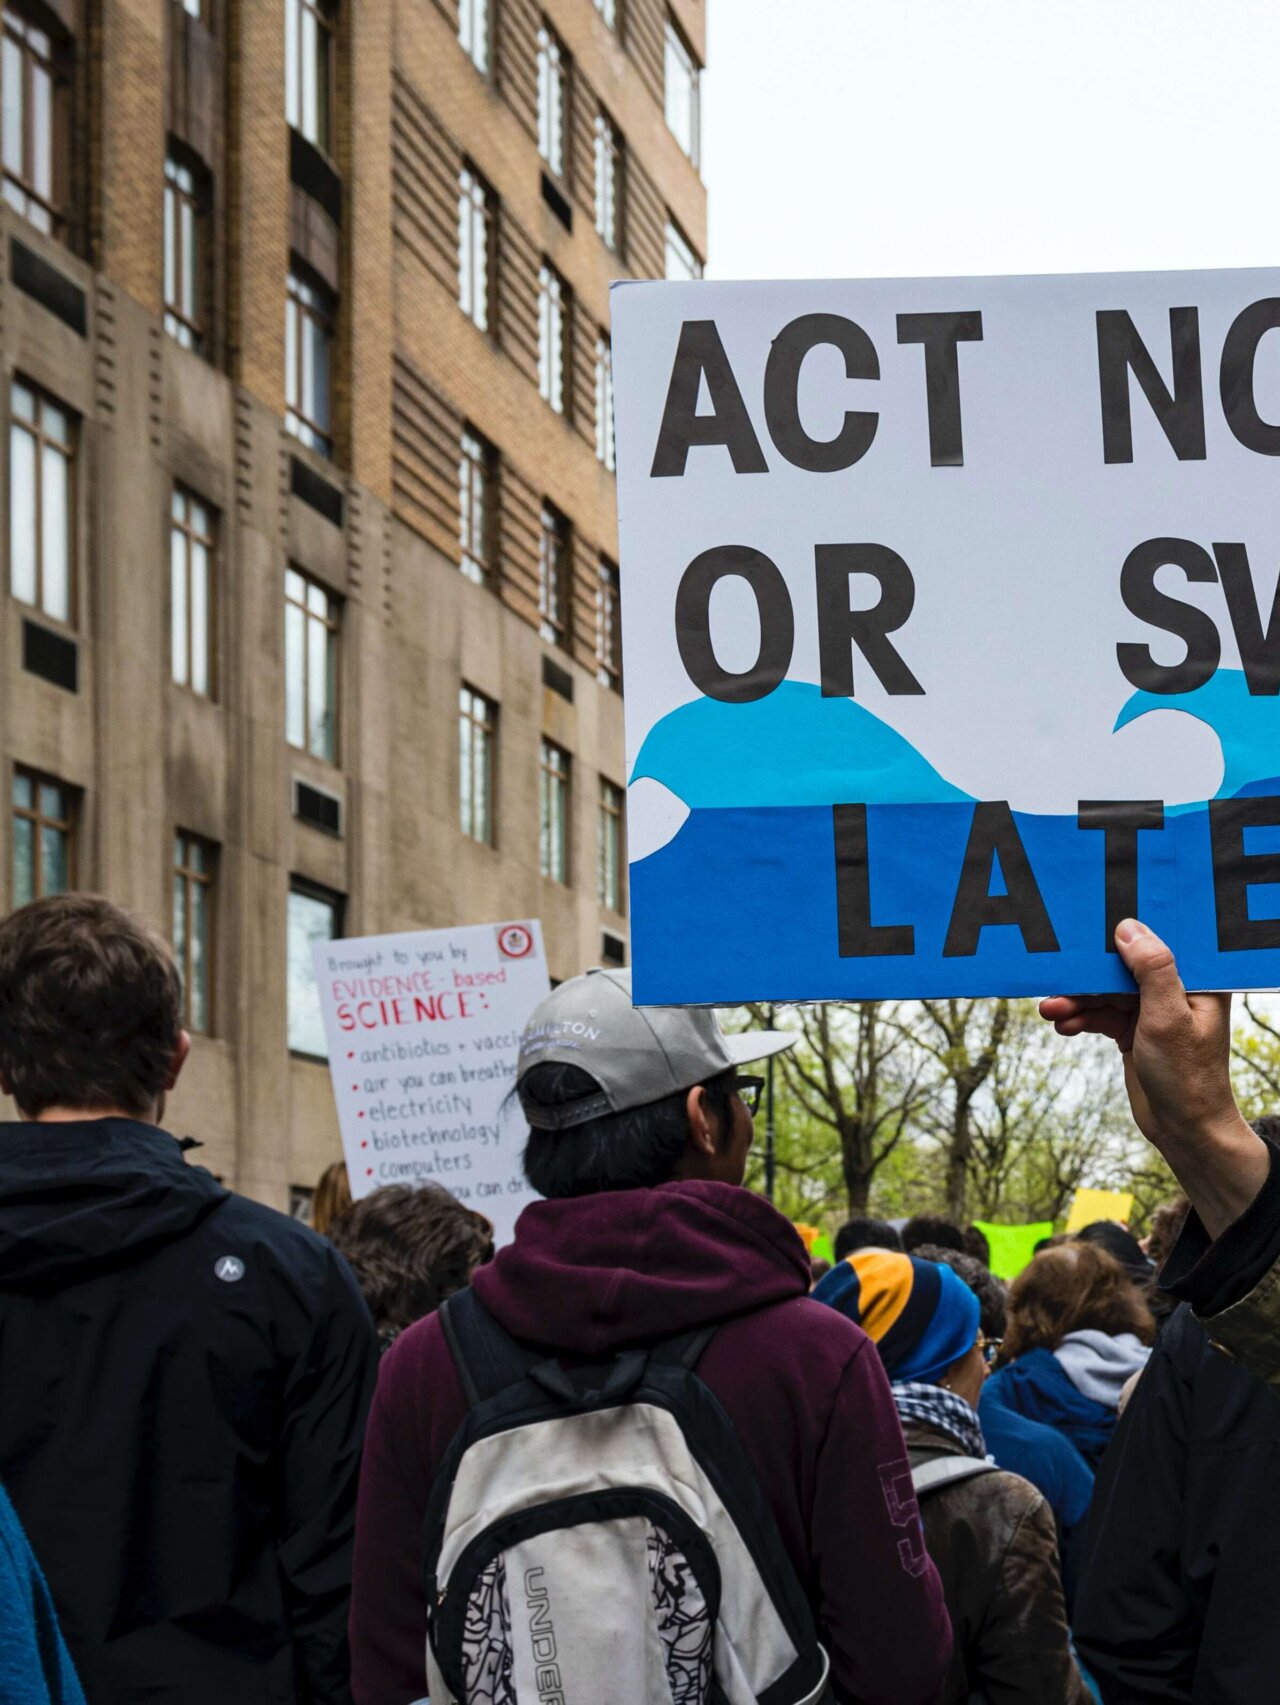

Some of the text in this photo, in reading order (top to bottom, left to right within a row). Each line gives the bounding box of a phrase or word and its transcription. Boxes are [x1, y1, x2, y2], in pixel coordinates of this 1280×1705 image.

[650, 311, 983, 478] ACT
[674, 543, 926, 705] OR
[393, 948, 409, 966] to
[414, 950, 445, 966] you
[448, 941, 468, 963] by
[336, 991, 489, 1032] SCIENCE:
[472, 1030, 522, 1052] vacci
[363, 1075, 389, 1094] air
[399, 1077, 424, 1095] you
[429, 1069, 457, 1087] can
[368, 1094, 473, 1121] electricity
[372, 1122, 500, 1151] biotechnology
[379, 1150, 473, 1180] computers
[453, 1186, 471, 1199] ou
[476, 1181, 504, 1198] can
